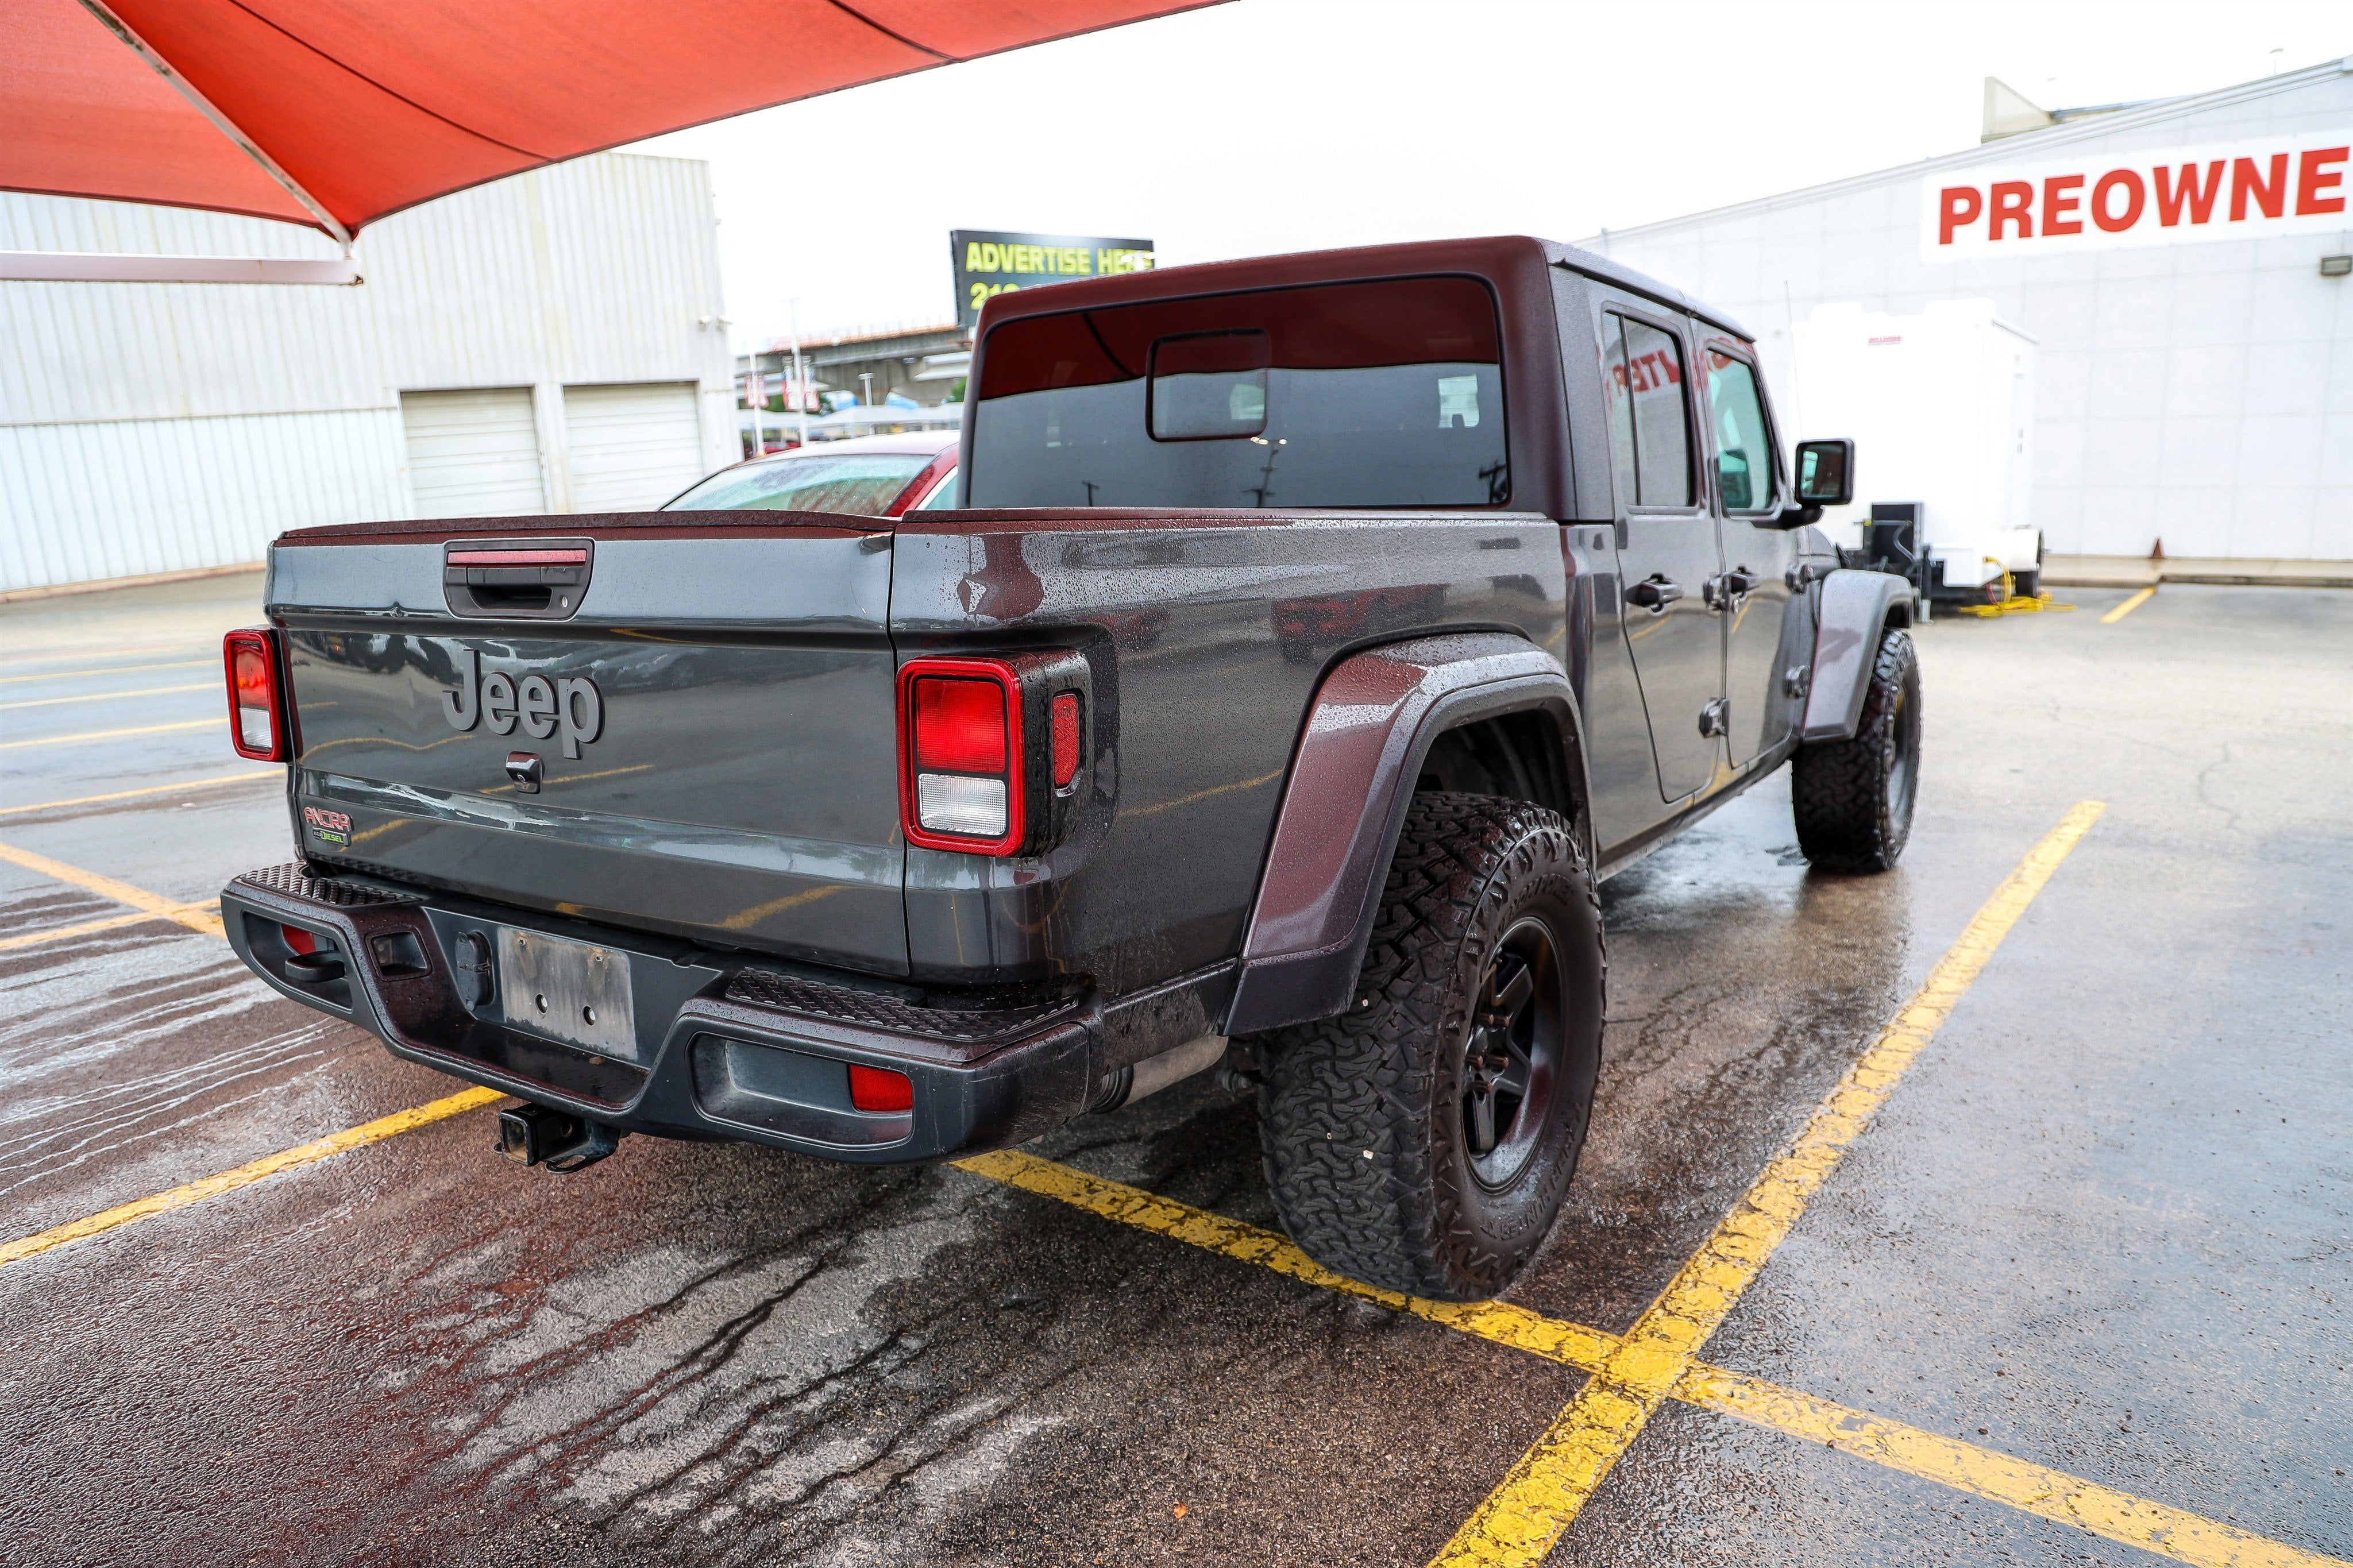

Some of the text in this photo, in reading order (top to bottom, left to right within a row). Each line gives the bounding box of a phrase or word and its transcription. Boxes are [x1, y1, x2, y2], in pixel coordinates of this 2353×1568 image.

[1939, 146, 2351, 245] PREOWNE
[966, 242, 1091, 276] ADVERTISE
[442, 649, 605, 759] Jeep
